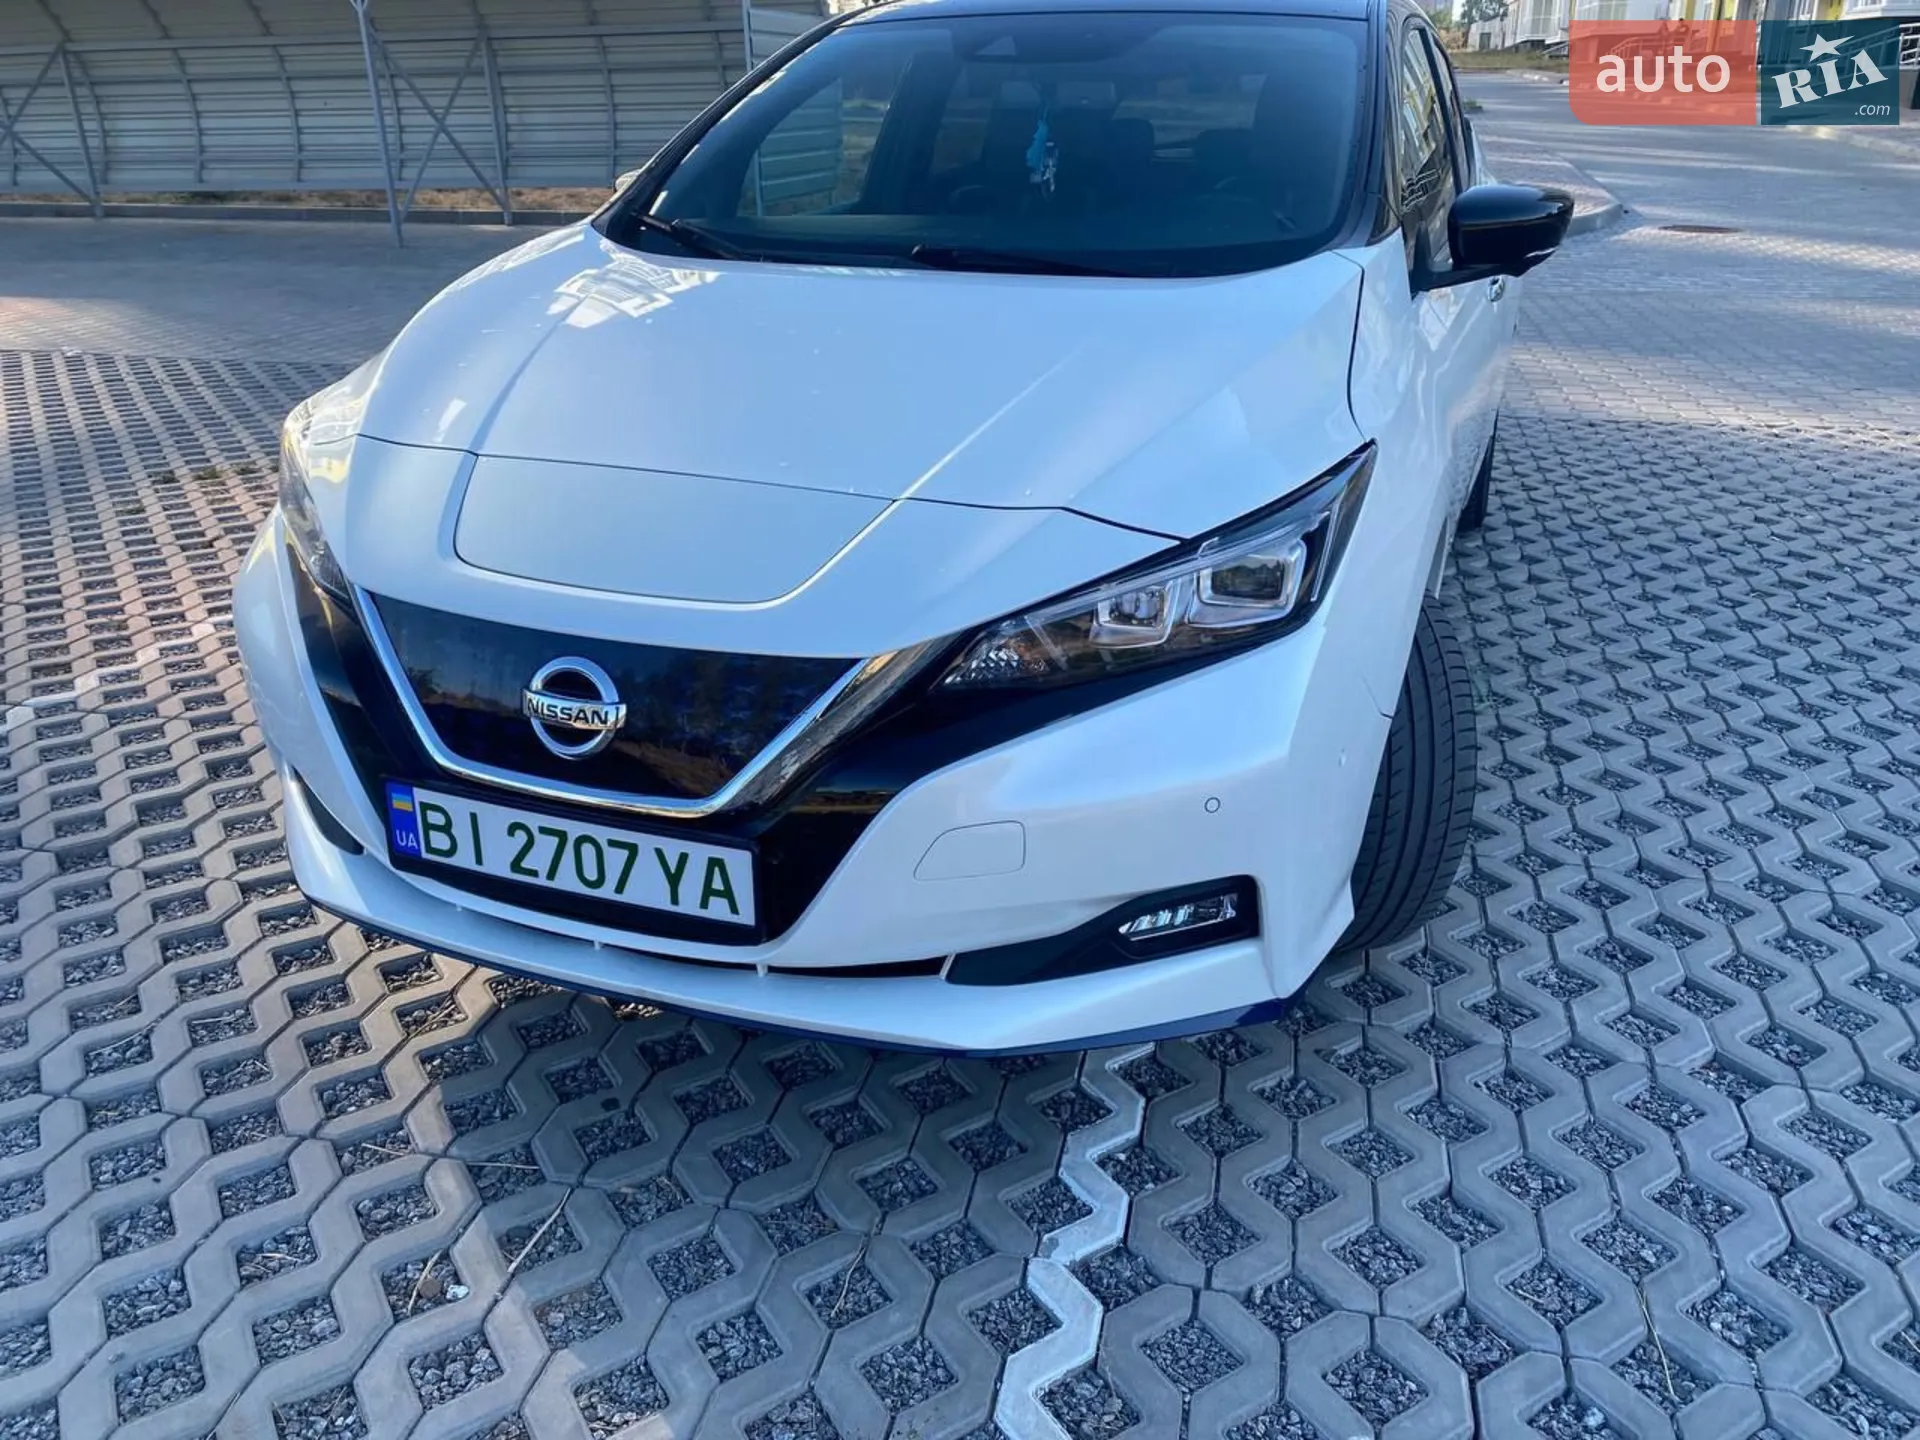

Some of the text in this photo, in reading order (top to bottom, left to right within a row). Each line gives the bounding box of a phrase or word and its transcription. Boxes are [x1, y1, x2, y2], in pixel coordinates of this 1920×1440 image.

[527, 697, 609, 725] NISSAN
[395, 829, 418, 850] UA
[419, 801, 740, 915] BI 2707 YA
